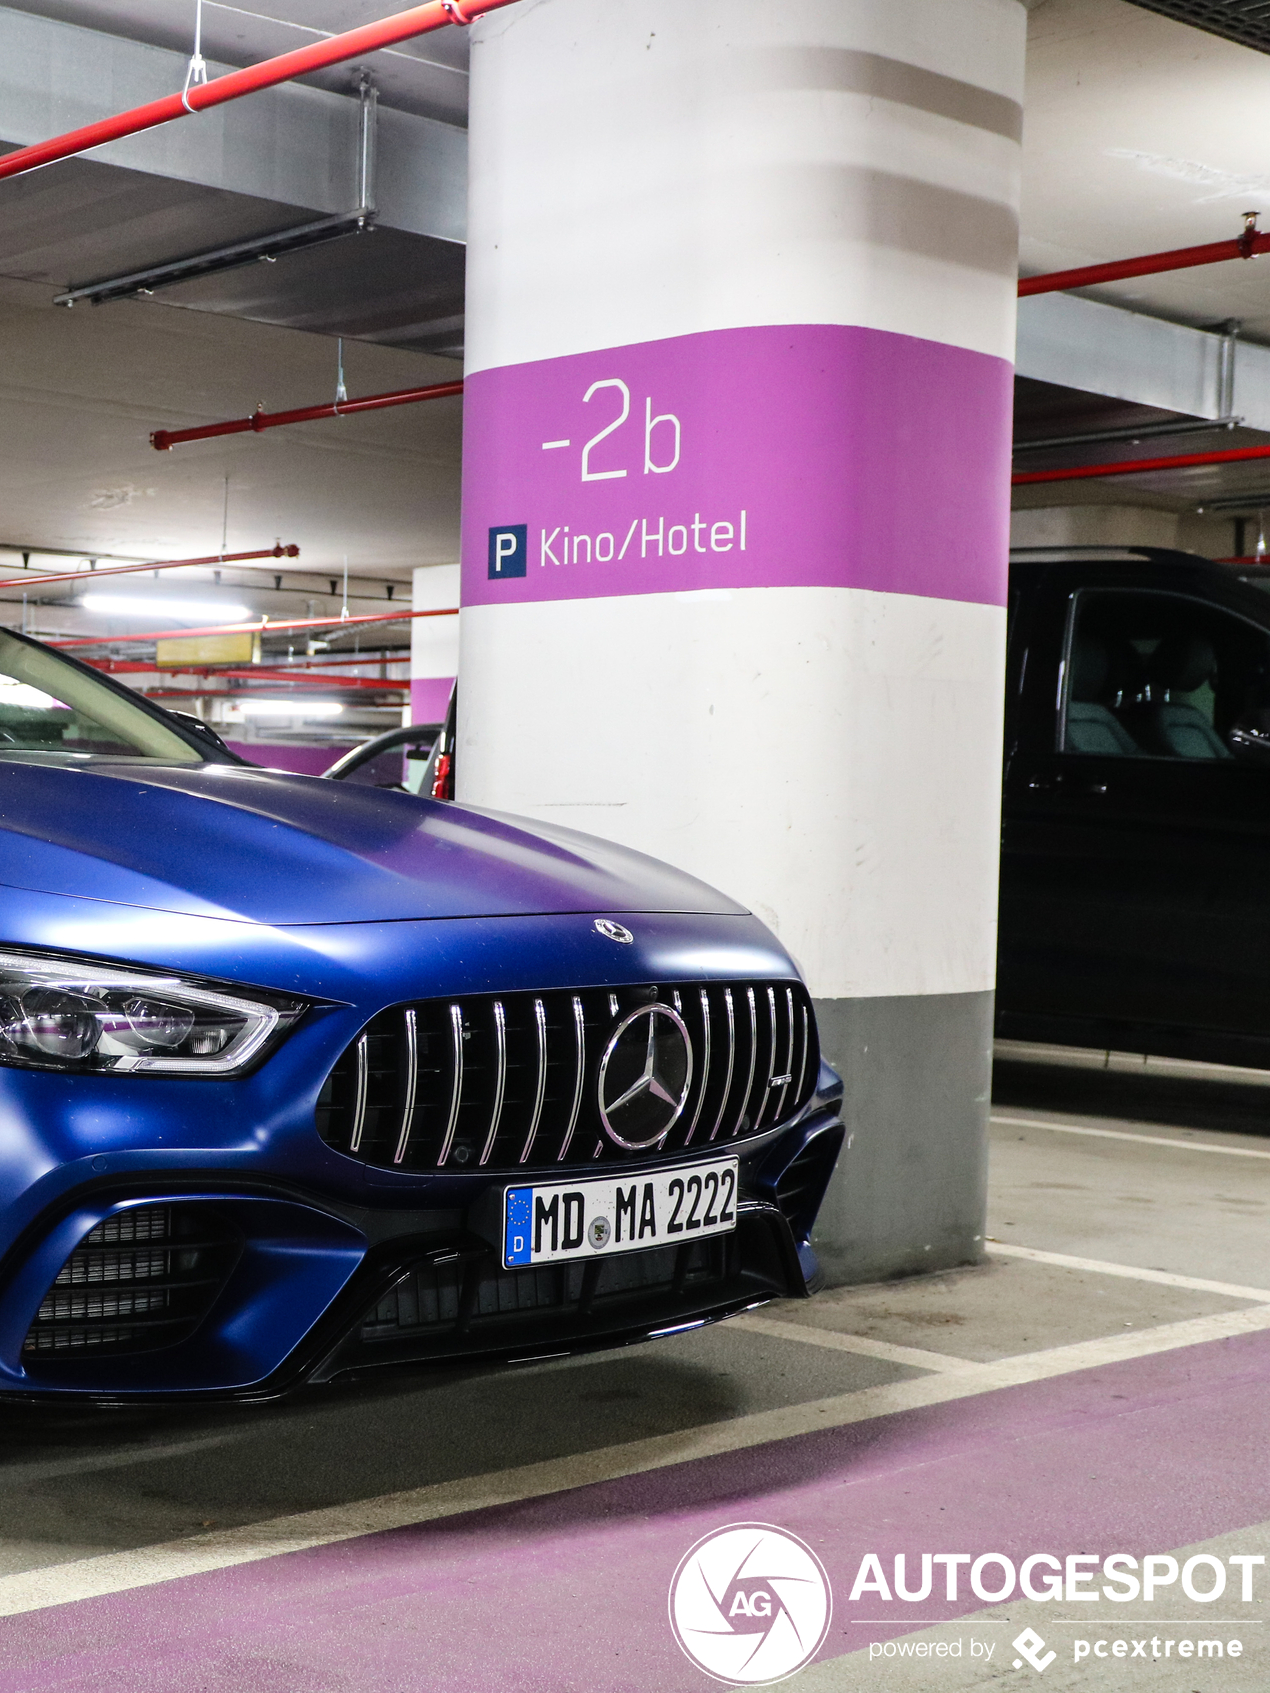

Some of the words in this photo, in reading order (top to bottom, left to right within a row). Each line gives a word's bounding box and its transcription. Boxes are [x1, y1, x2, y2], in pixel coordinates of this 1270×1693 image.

[541, 378, 681, 482] -2b
[495, 533, 518, 572] P
[540, 510, 747, 567] Kino/Hotel
[513, 1236, 524, 1253] D
[534, 1191, 585, 1253] MD
[614, 1182, 656, 1243] MA
[666, 1168, 735, 1234] 2222
